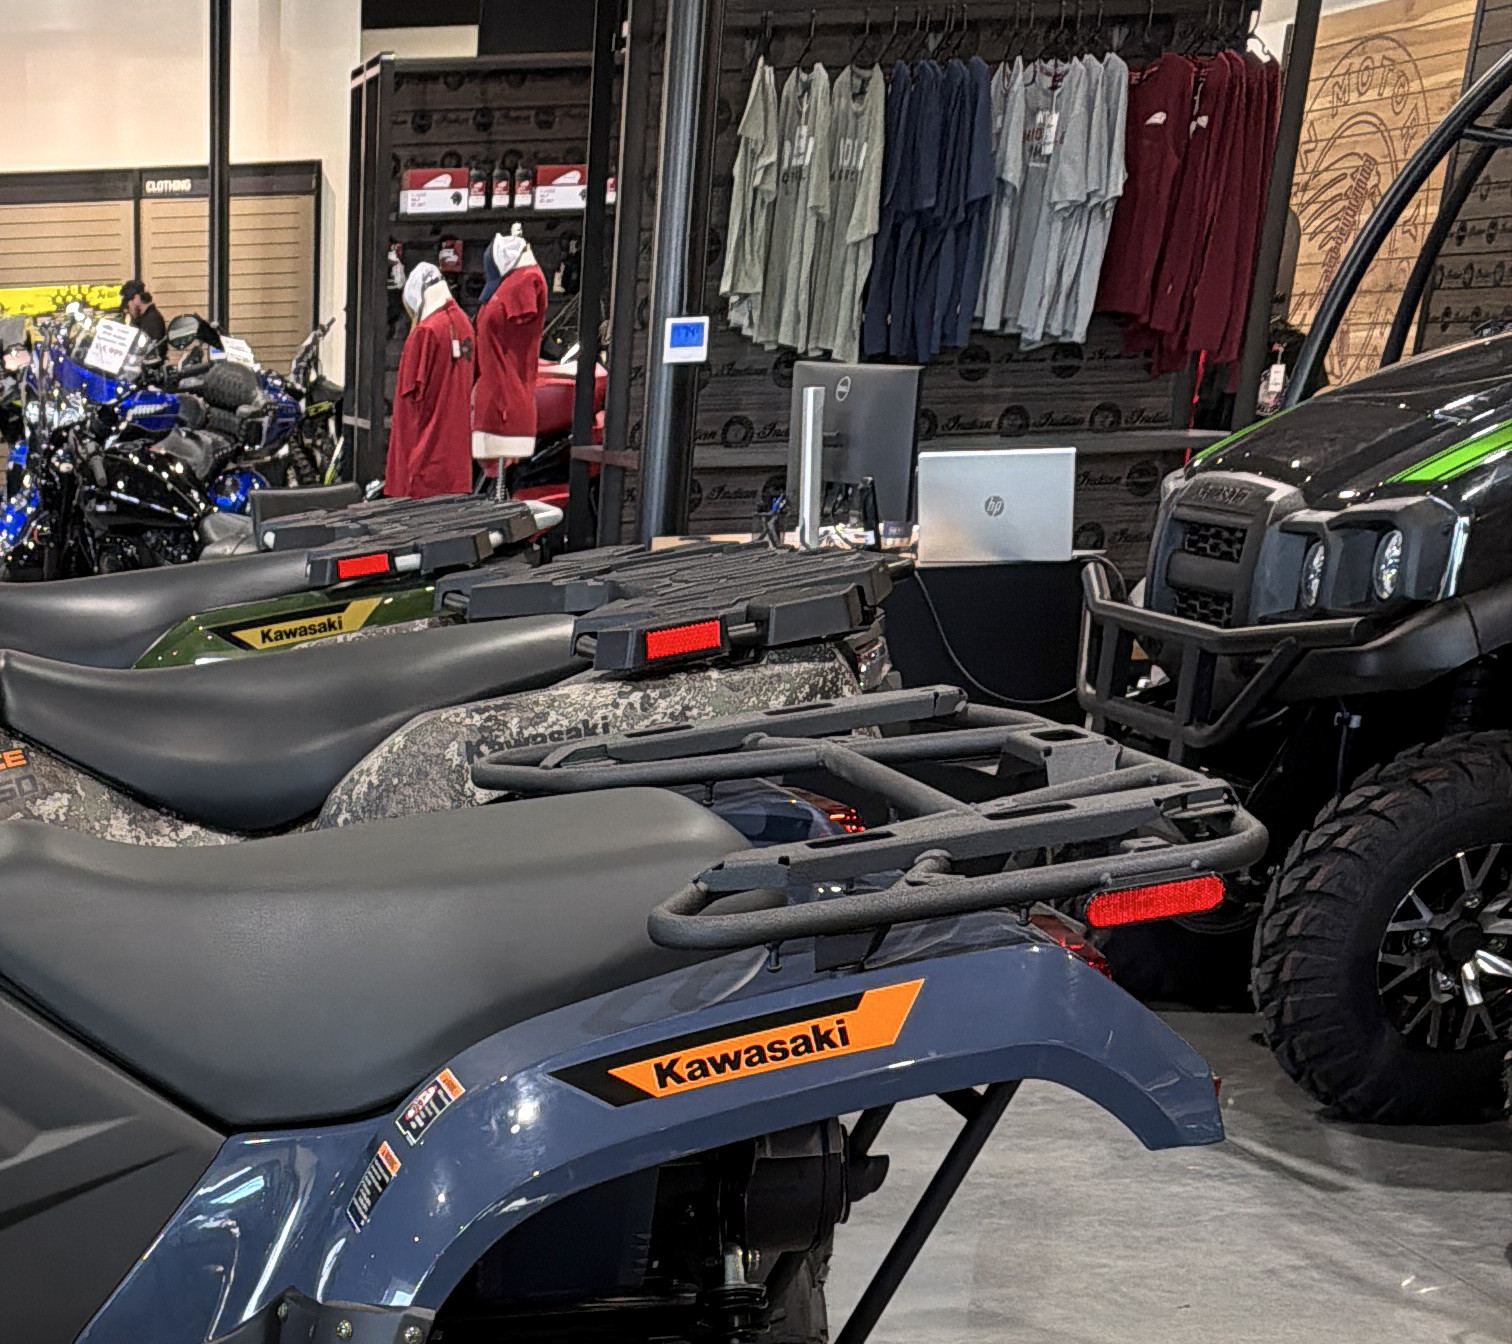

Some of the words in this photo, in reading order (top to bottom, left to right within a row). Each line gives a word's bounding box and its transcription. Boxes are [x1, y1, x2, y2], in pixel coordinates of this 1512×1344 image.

[145, 178, 192, 194] CLOTHING
[713, 361, 768, 377] Indian
[941, 414, 994, 432] Indian
[1032, 411, 1086, 428] Indian
[1124, 407, 1170, 424] India
[985, 497, 1003, 517] hp
[1108, 527, 1152, 544] India
[260, 616, 343, 645] Kawasaki
[654, 1019, 850, 1089] Kawasaki
